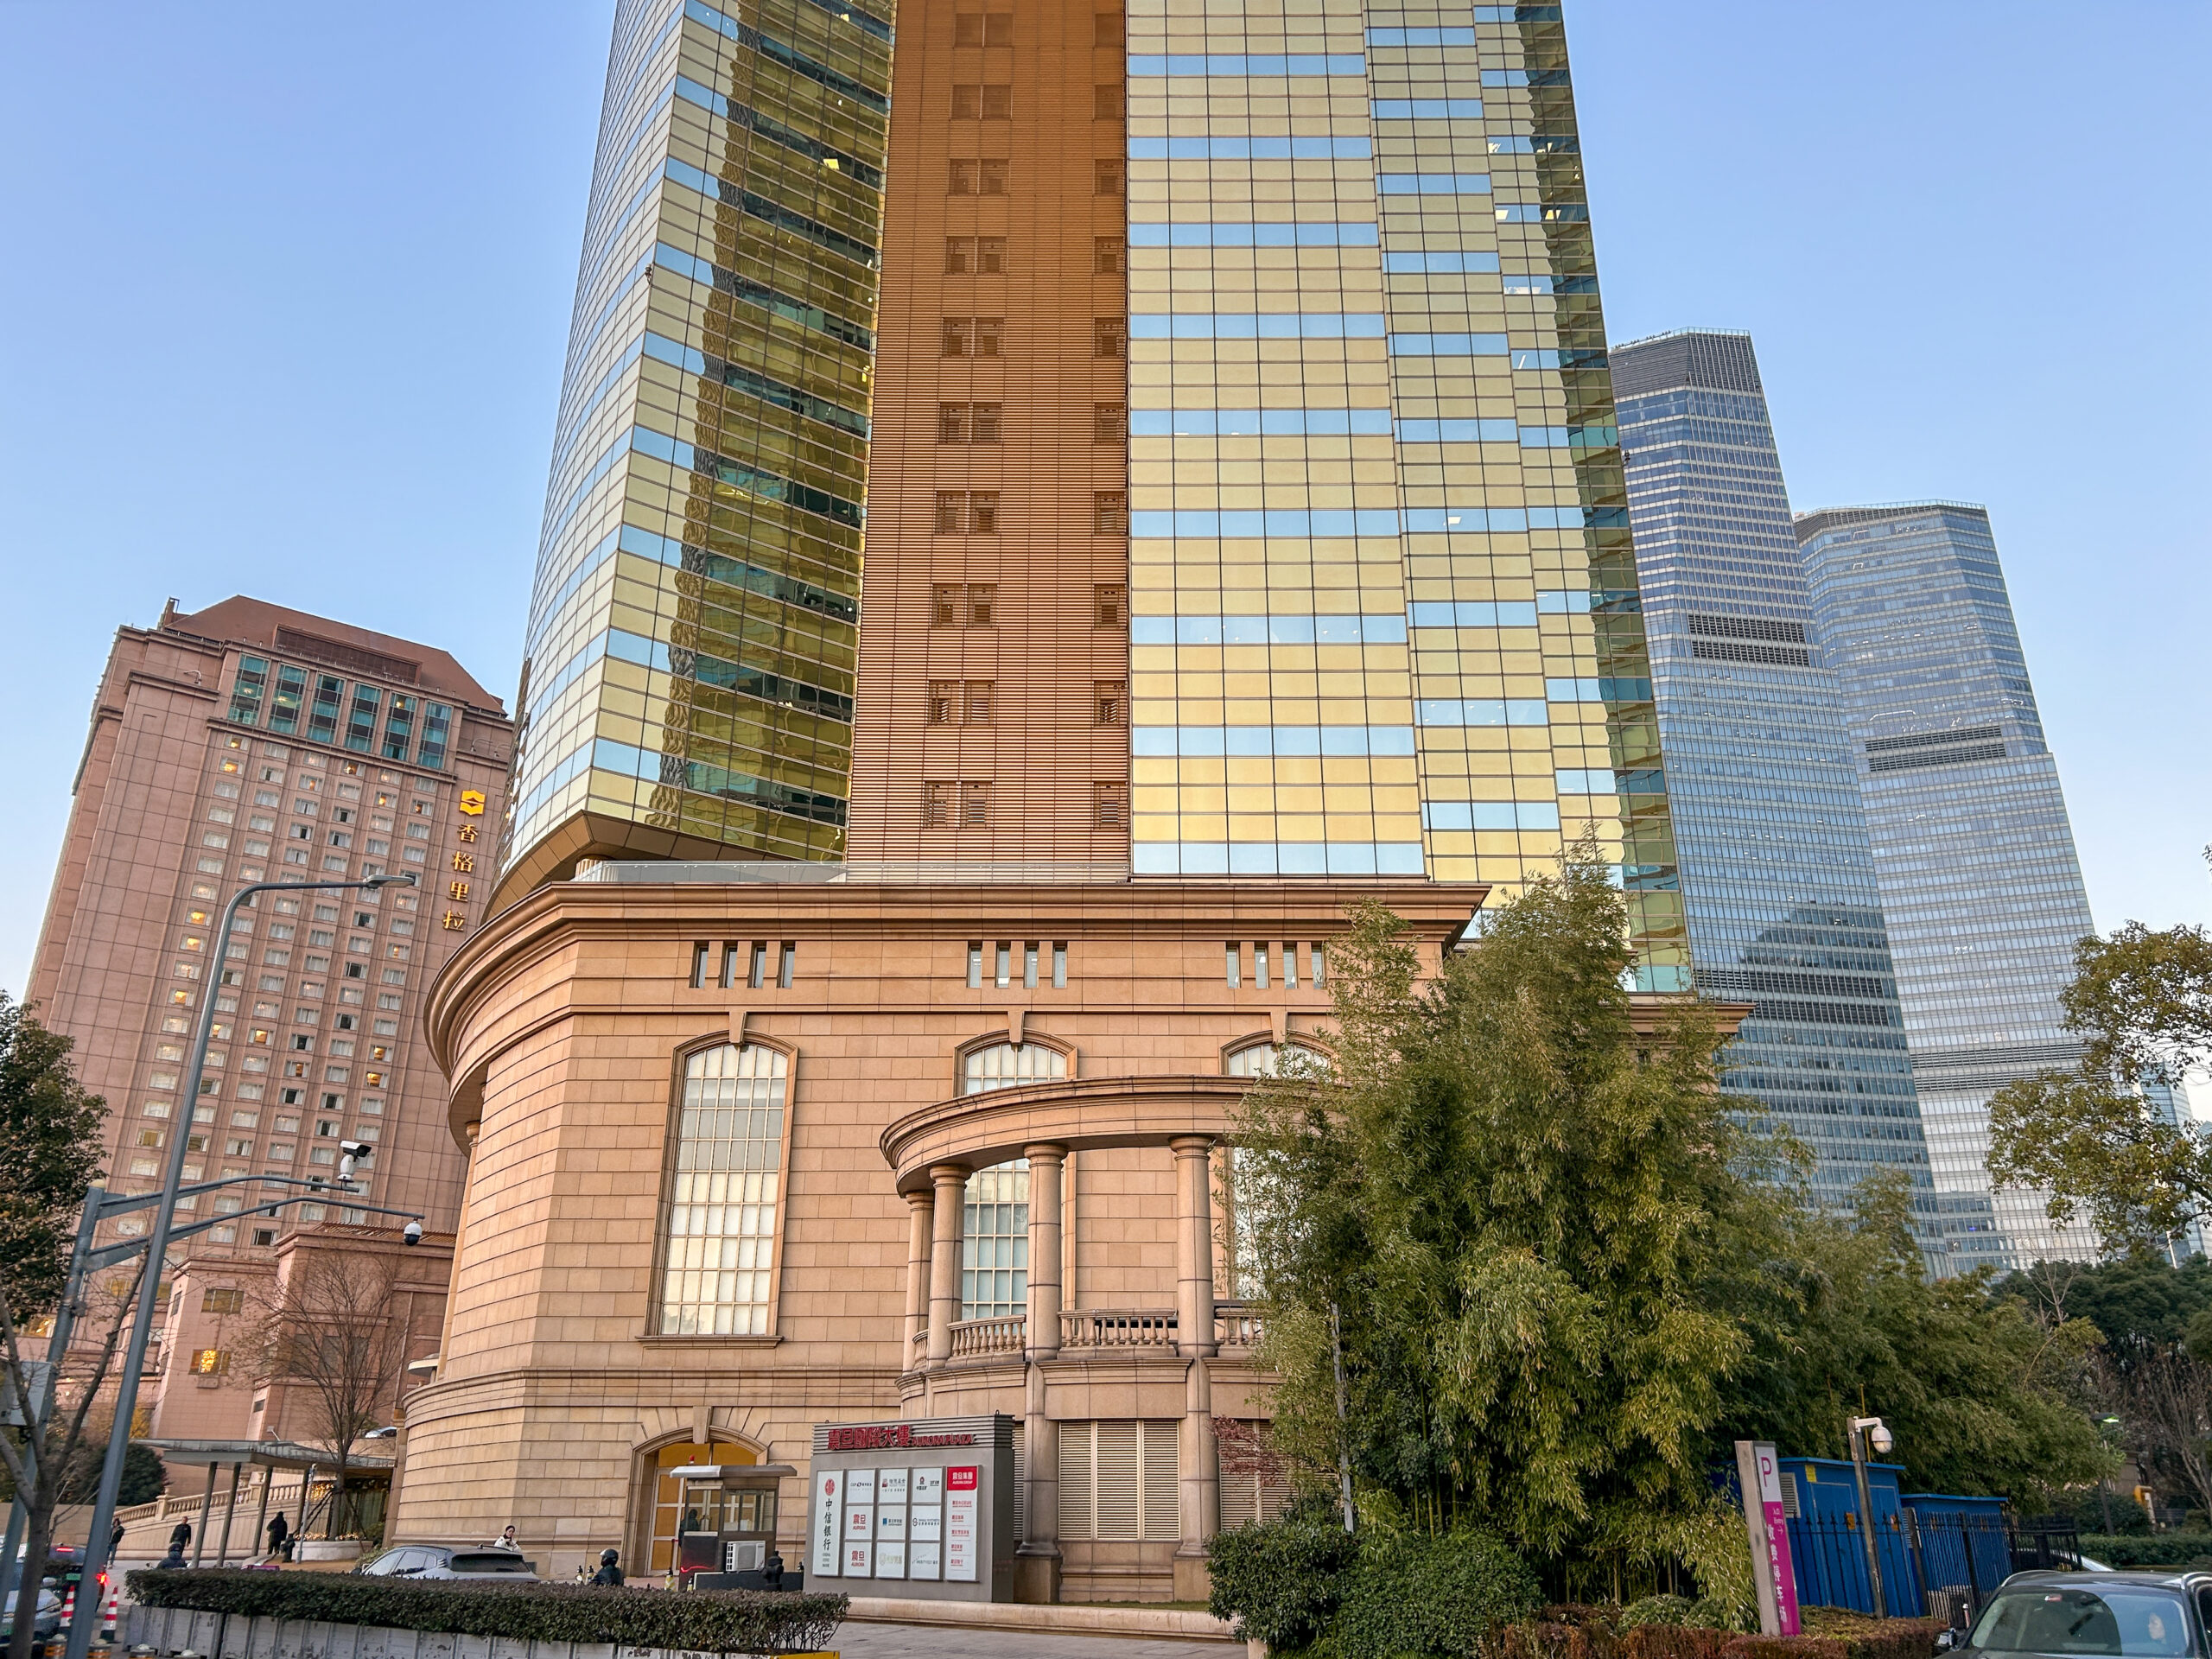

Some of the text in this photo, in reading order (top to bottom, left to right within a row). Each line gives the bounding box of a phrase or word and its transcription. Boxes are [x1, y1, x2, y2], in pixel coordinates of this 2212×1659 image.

[442, 823, 478, 931] 香格里拉
[828, 1425, 910, 1450] 震旦國際大樓
[912, 1433, 974, 1446] AURORA PLAZA
[1761, 1457, 1771, 1487] P
[823, 1498, 832, 1551] 中信银行
